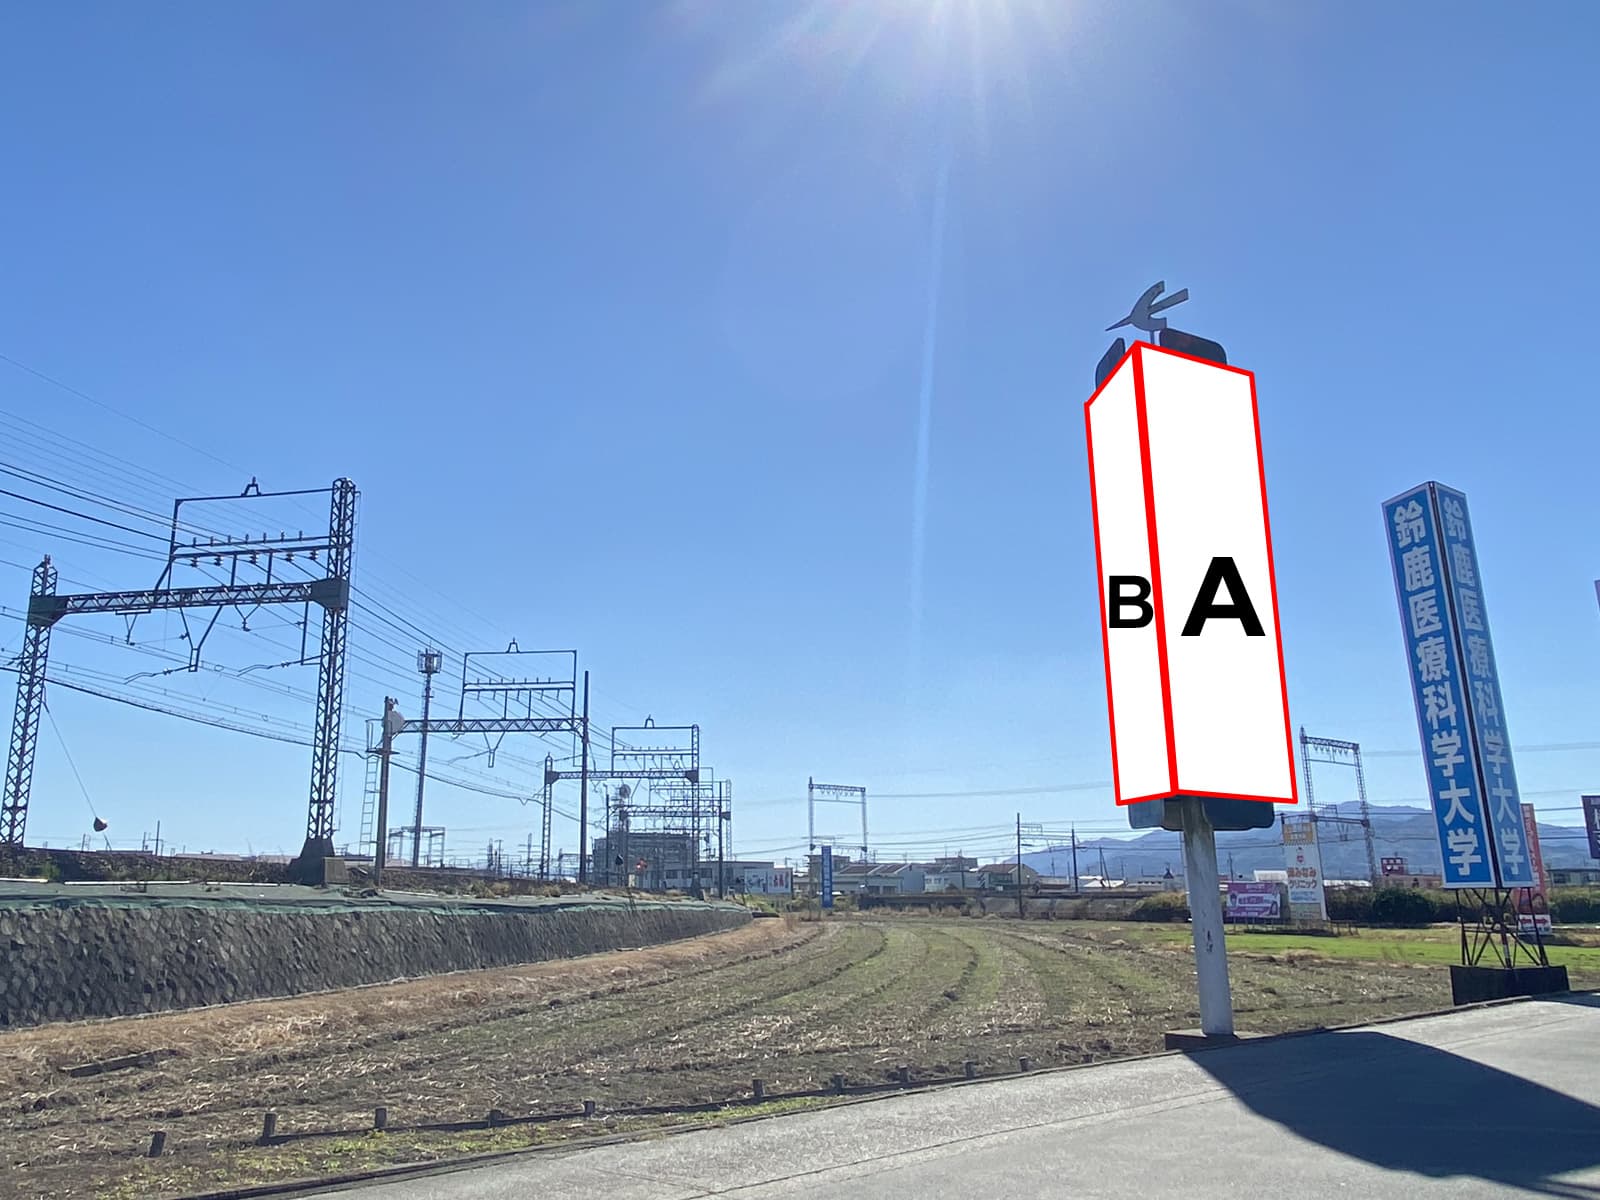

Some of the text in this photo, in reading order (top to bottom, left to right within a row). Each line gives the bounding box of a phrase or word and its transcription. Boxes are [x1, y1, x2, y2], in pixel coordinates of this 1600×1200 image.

[1394, 500, 1482, 876] 鈴鹿医療科学大学
[1443, 497, 1525, 875] 鈴鹿医療科学大学
